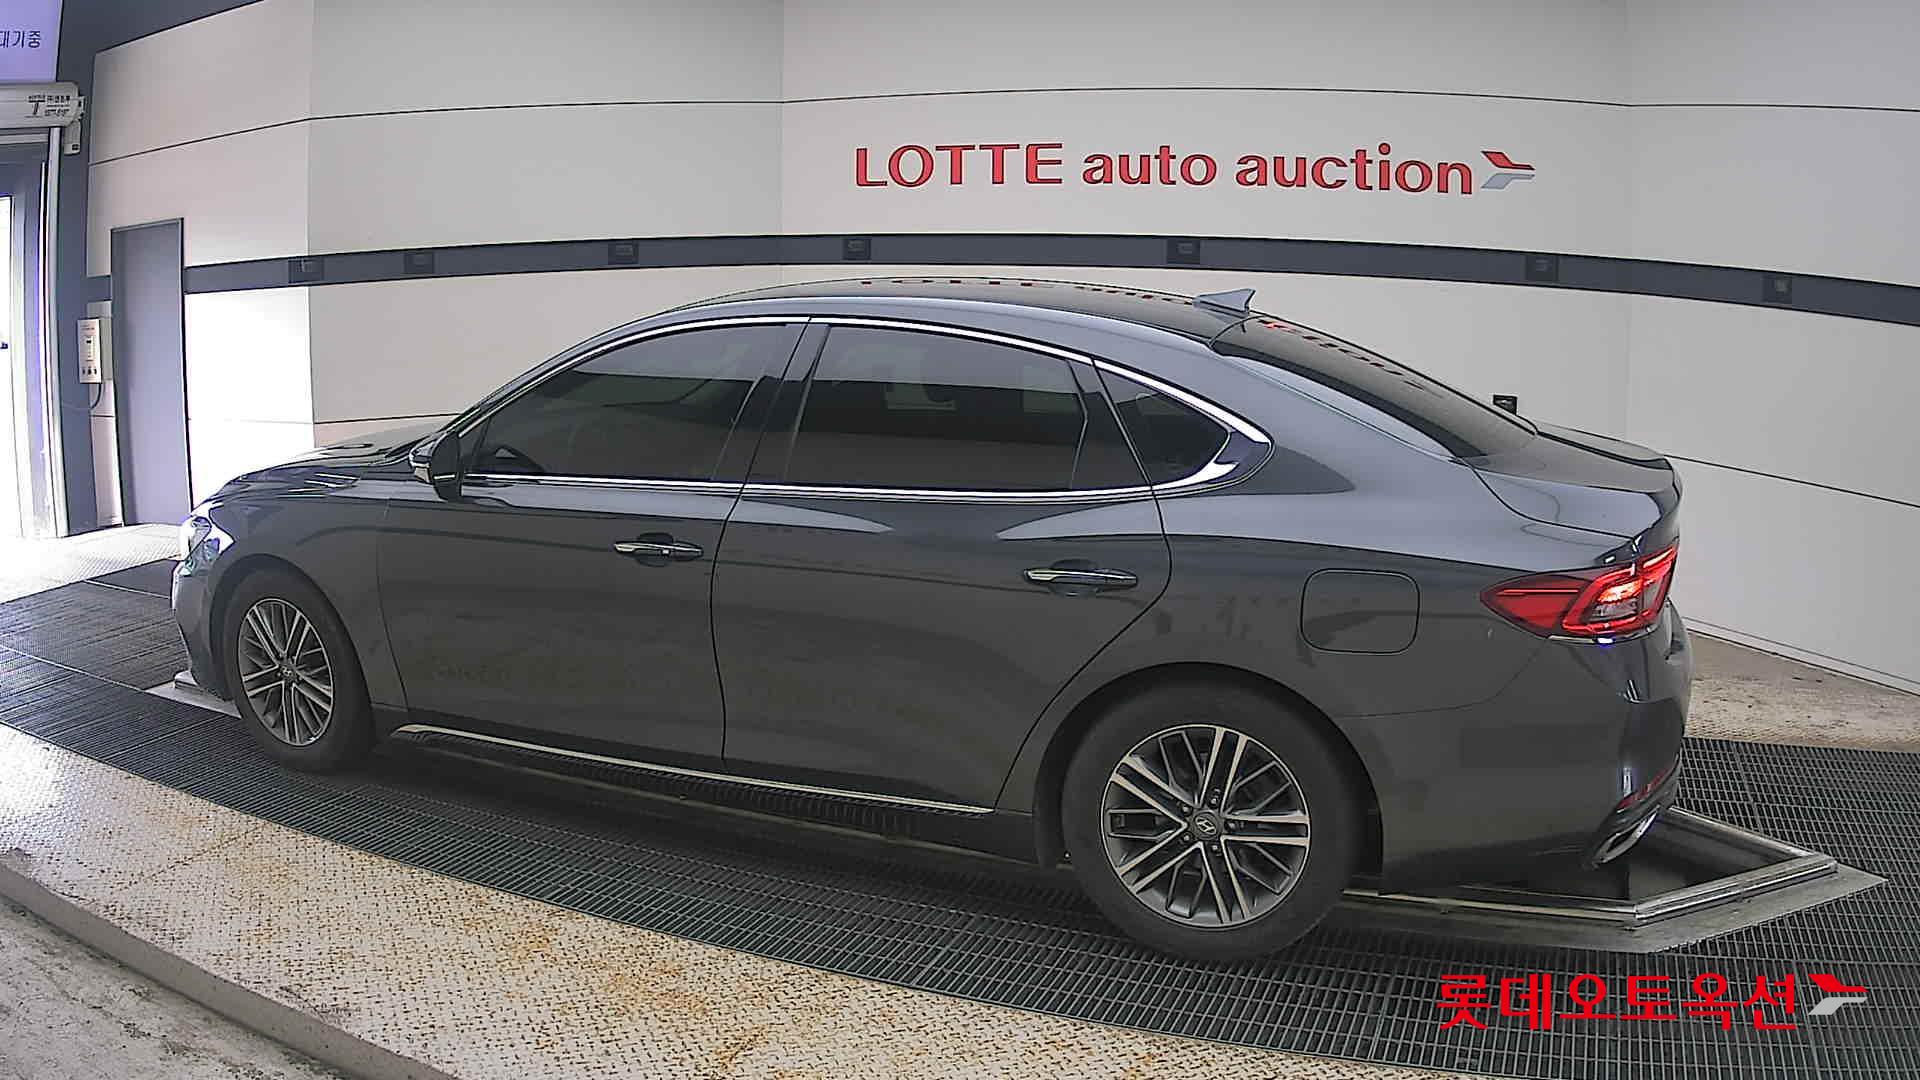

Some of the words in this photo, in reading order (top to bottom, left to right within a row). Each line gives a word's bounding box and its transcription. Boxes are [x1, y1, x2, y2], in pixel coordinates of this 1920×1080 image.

[855, 143, 1062, 188] LOTTE
[1083, 145, 1218, 186] auto
[1236, 143, 1474, 195] auction
